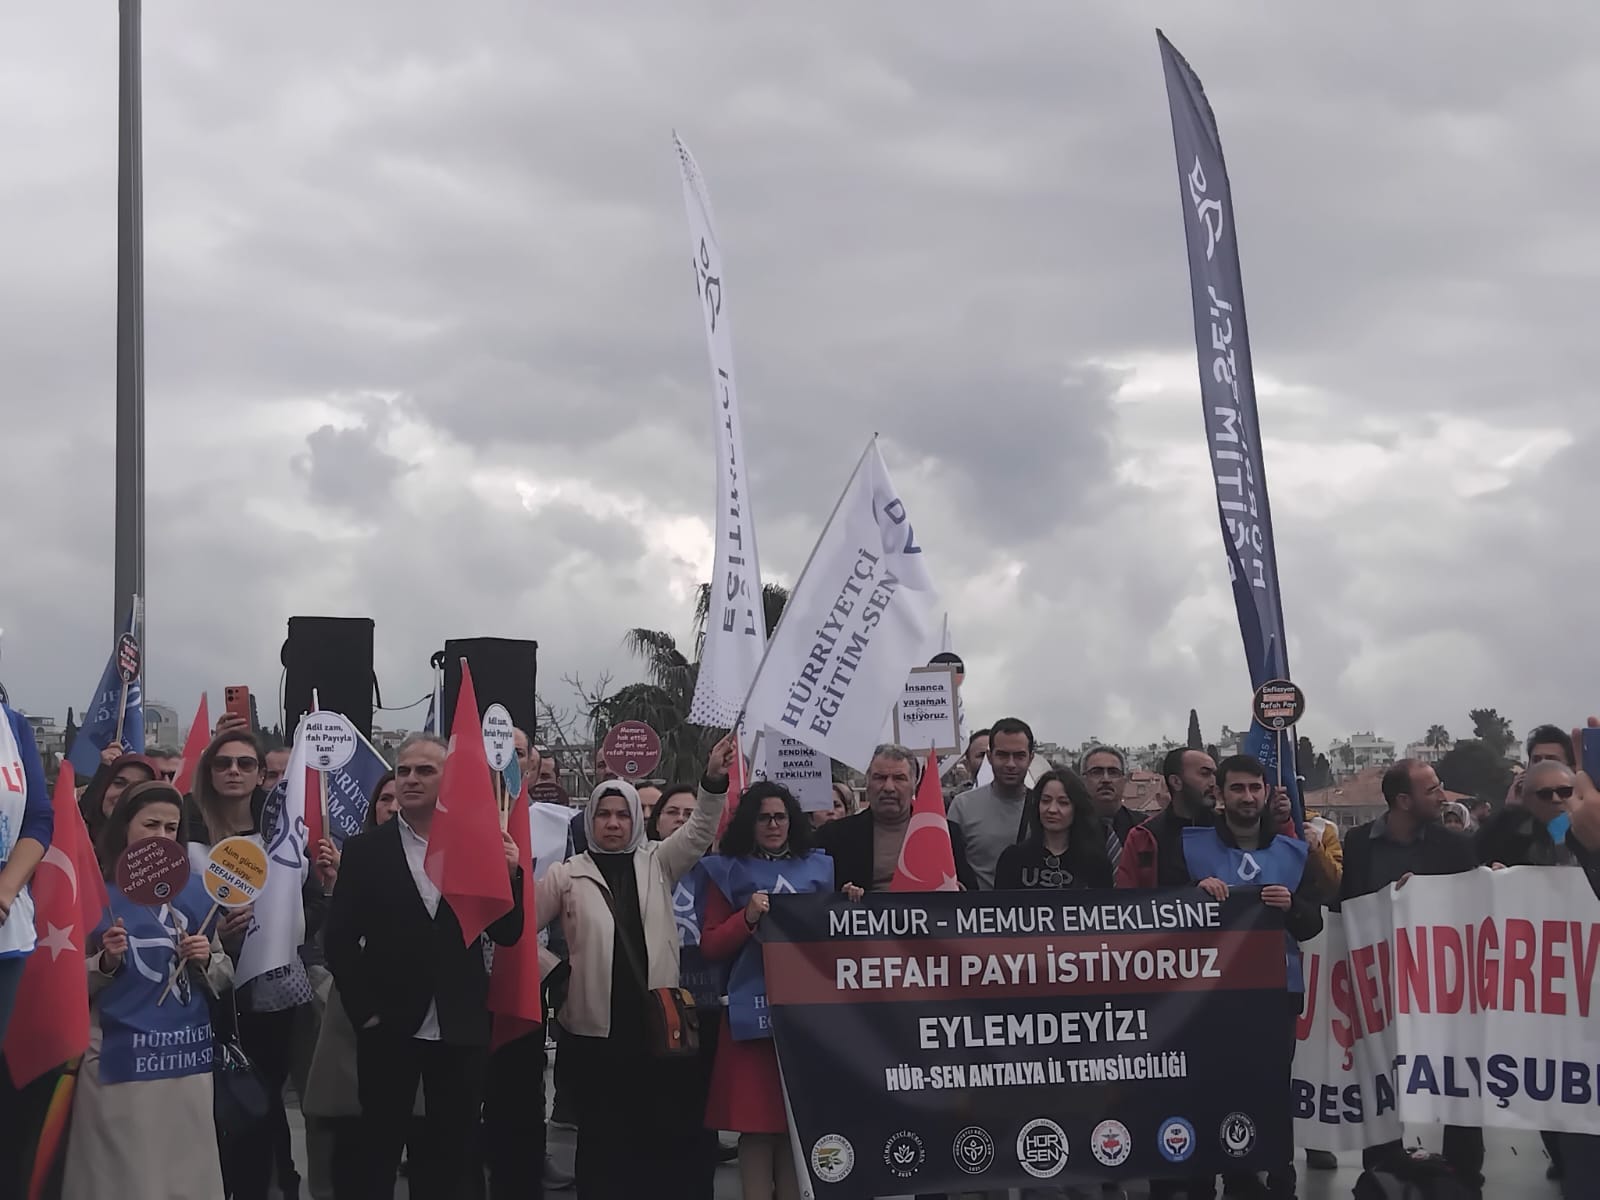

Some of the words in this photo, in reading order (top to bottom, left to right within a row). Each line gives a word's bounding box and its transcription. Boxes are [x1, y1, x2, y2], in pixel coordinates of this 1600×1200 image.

[781, 547, 880, 729] HÜRRİYETÇİ
[810, 569, 901, 737] EĞİTİM-SEN
[903, 697, 947, 708] yaşamak
[903, 712, 948, 722] istiyoruz.
[305, 723, 323, 731] Adil
[324, 724, 343, 732] zam,
[306, 733, 321, 742] fah
[322, 734, 352, 743] Payıyla
[315, 744, 335, 753] Tam!
[783, 759, 813, 768] BAYAĞI
[774, 771, 822, 779] TEPKİLİYİM
[127, 841, 158, 860] Memura
[127, 859, 143, 870] hak
[144, 847, 166, 863] ettiği
[129, 863, 155, 881] değeri
[221, 859, 235, 870] can
[239, 854, 265, 876] gücüne
[123, 878, 147, 893] refah
[208, 862, 235, 885] REFAH
[234, 877, 255, 896] PAYI!
[829, 908, 930, 936] MEMUR
[956, 904, 1055, 934] MEMUR
[1062, 898, 1222, 931] EMEKLİSİNE
[836, 956, 949, 990] REFAH
[961, 951, 1037, 987] PAYI
[1047, 943, 1222, 984] İSTİYORUZ
[919, 1001, 1149, 1050] EYLEMDEYİZ!
[132, 1022, 213, 1049] HÜRRİYET
[885, 1061, 966, 1092] HÜR-SEN
[969, 1058, 1047, 1088] ANTALYA
[1048, 1055, 1065, 1084] İL
[1066, 1050, 1188, 1083] TEMSİLCİLİĞİ
[1291, 1078, 1363, 1125] BES
[1486, 1053, 1600, 1109] ŞUB
[1026, 1147, 1060, 1162] SEN
